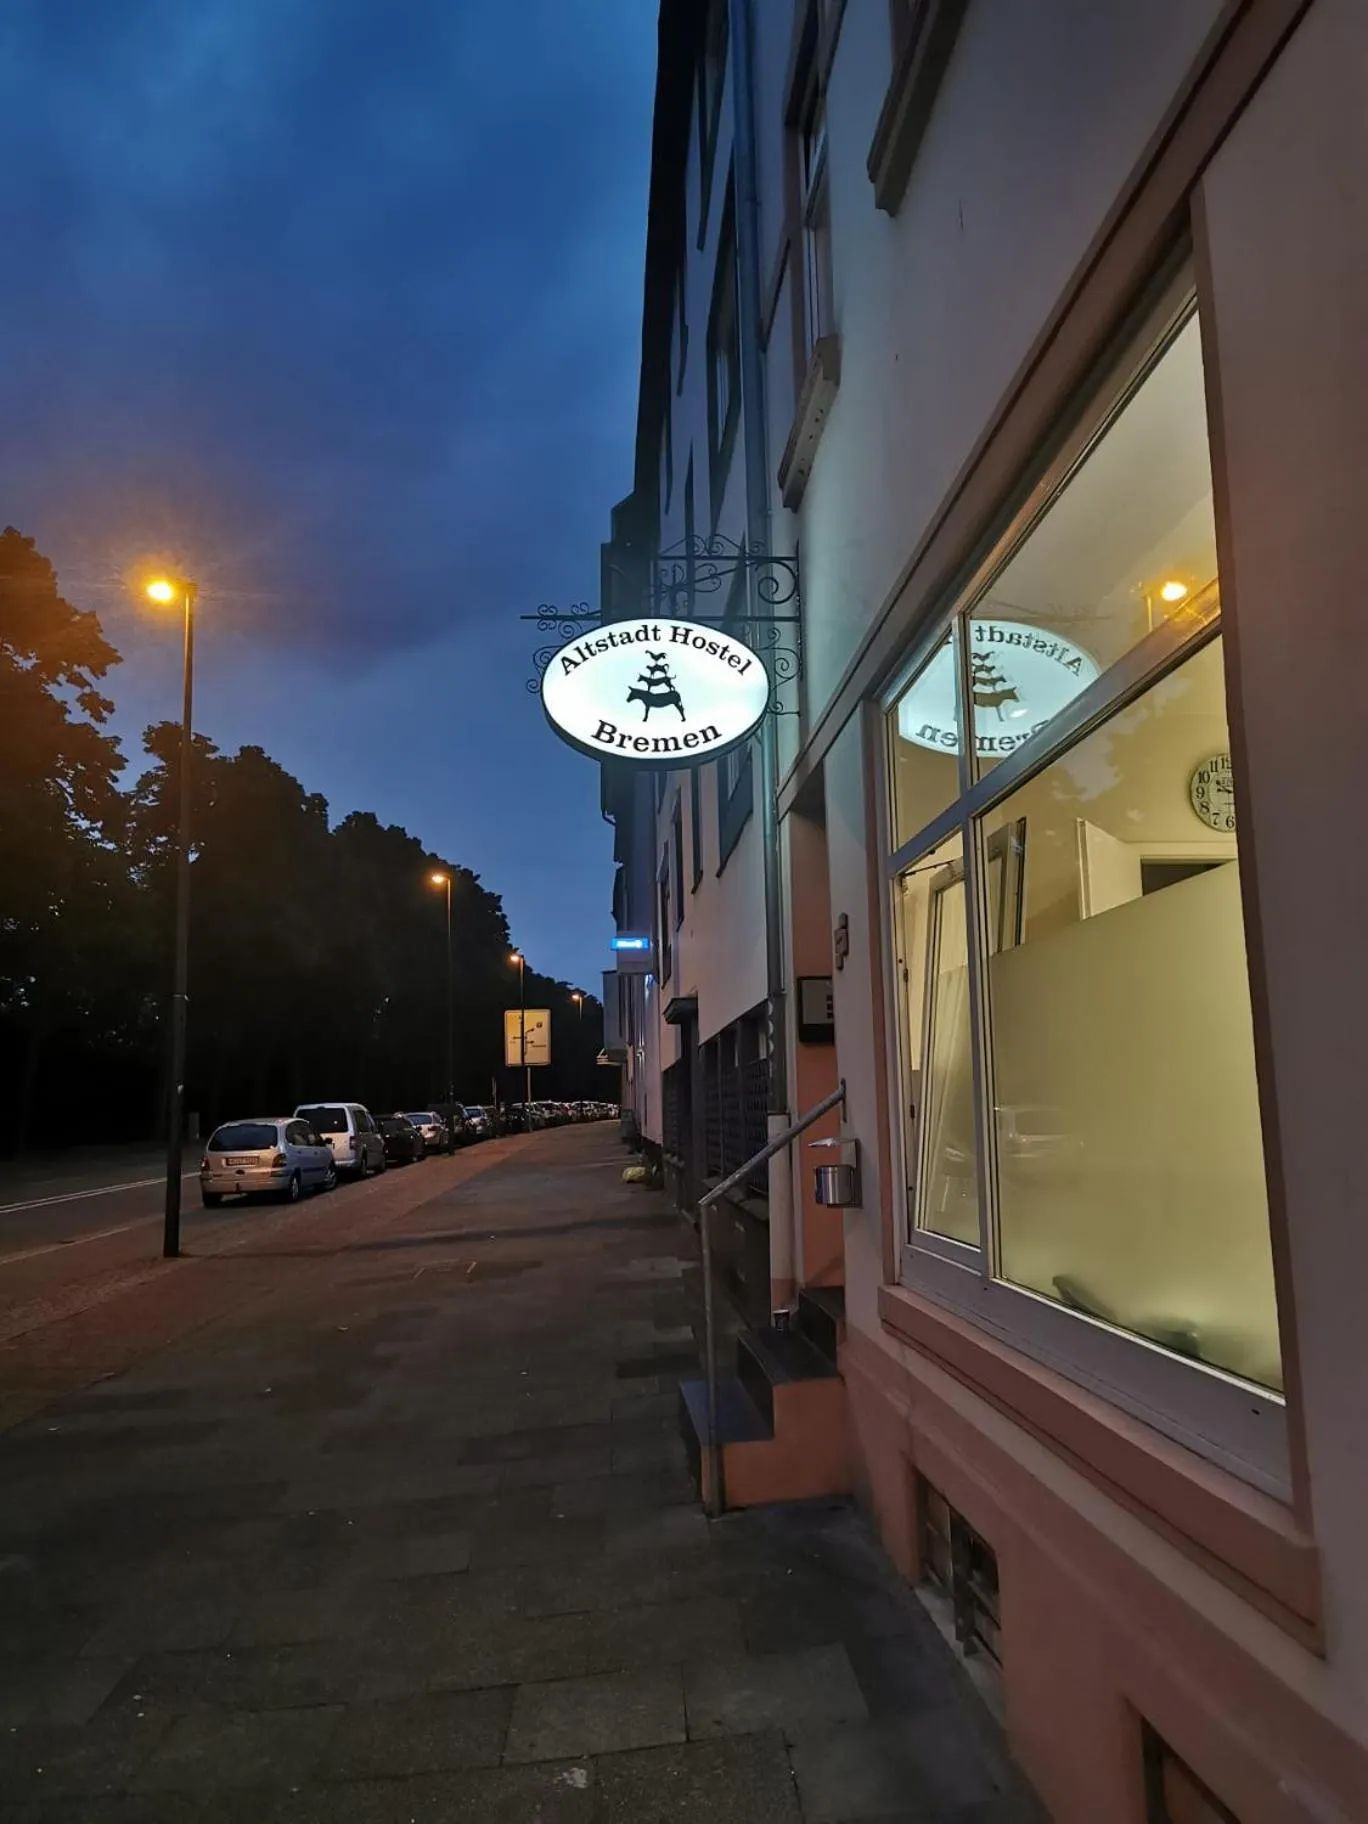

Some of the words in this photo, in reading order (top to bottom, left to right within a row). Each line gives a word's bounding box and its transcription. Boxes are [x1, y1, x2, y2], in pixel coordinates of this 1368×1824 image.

[560, 624, 661, 677] Altstadt
[668, 625, 752, 677] Hostel
[590, 719, 723, 753] Bremen
[1198, 770, 1211, 785] 10
[1195, 786, 1206, 800] 9
[1199, 800, 1210, 815] 8
[1212, 812, 1221, 826] 7
[1225, 815, 1235, 829] 6
